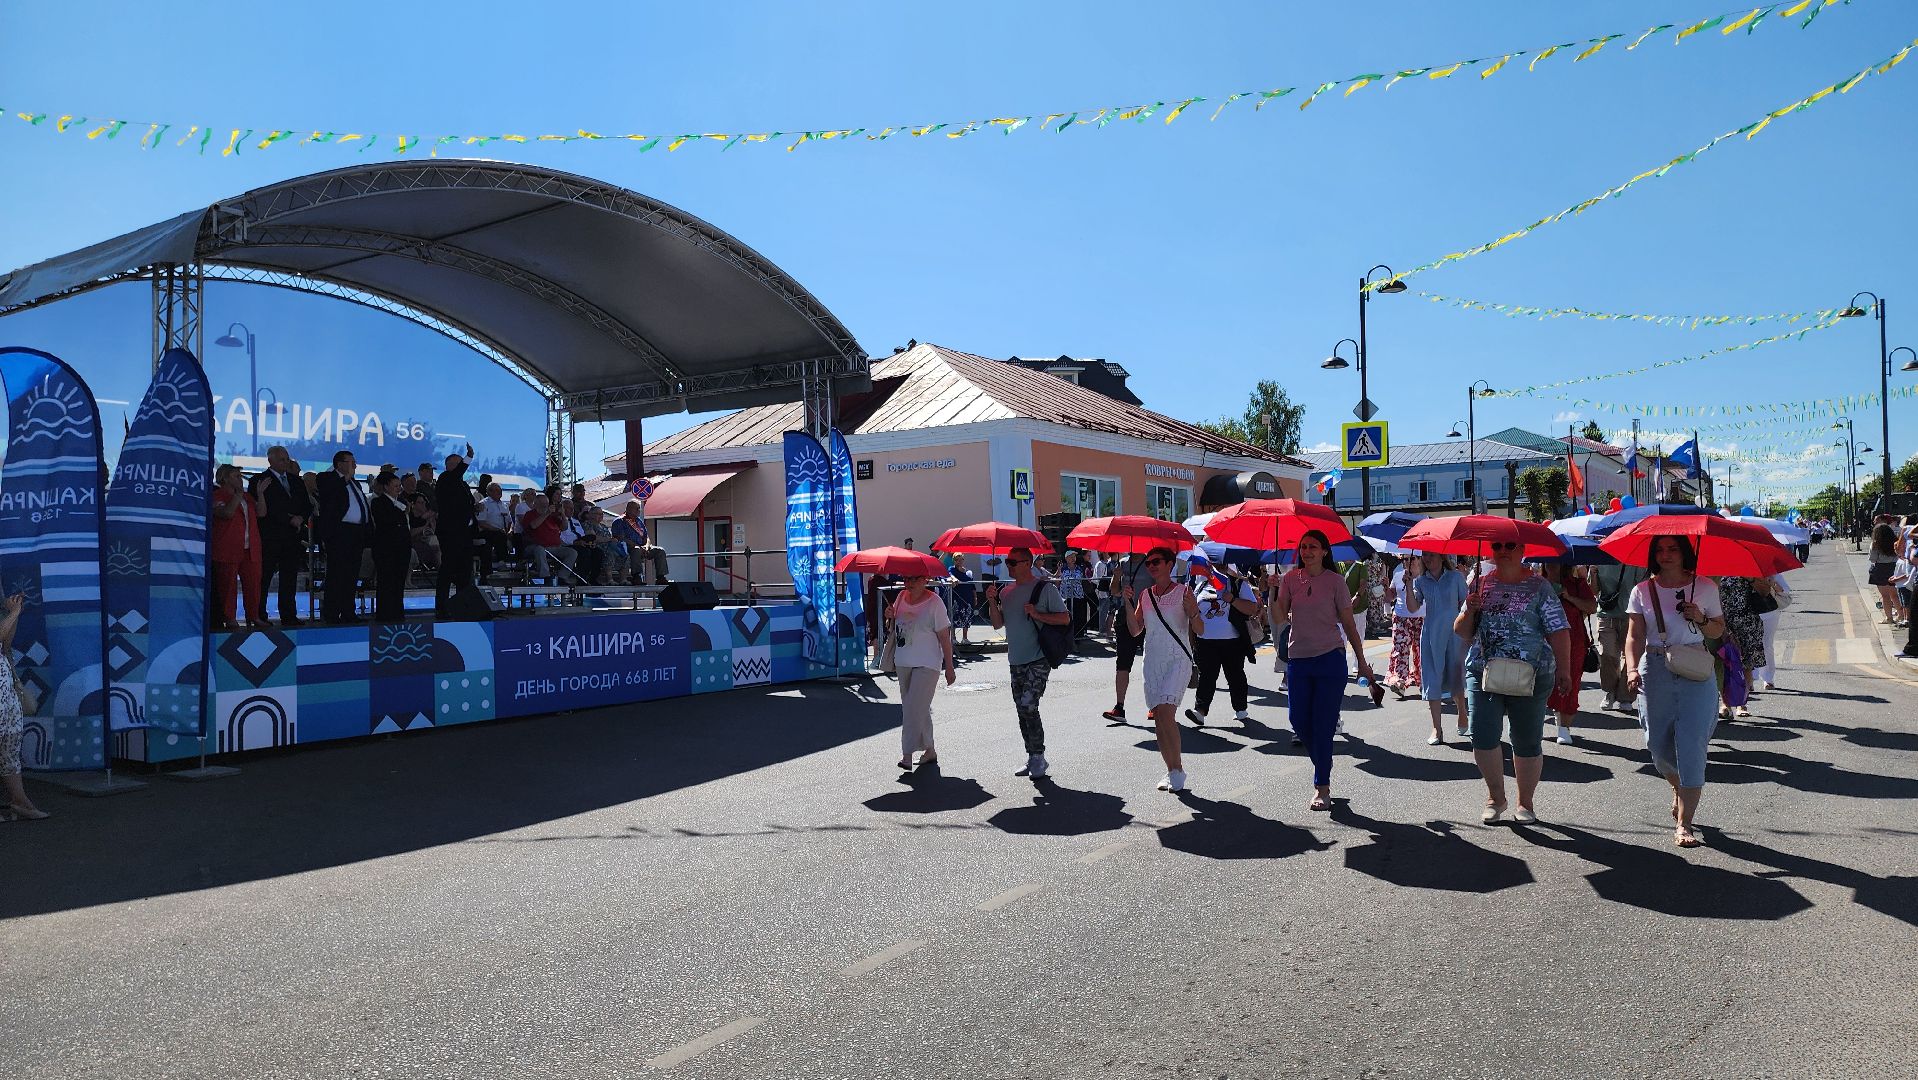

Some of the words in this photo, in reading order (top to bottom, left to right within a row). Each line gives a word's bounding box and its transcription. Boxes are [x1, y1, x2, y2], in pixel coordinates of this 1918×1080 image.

[397, 422, 425, 441] 56
[525, 643, 542, 655] 13
[549, 631, 645, 660] КАШИРА
[650, 634, 666, 646] 56
[514, 679, 556, 700] ДЕНЬ
[560, 672, 620, 693] ГОРОДА
[625, 669, 649, 685] 668
[653, 666, 677, 682] ЛЕТ
